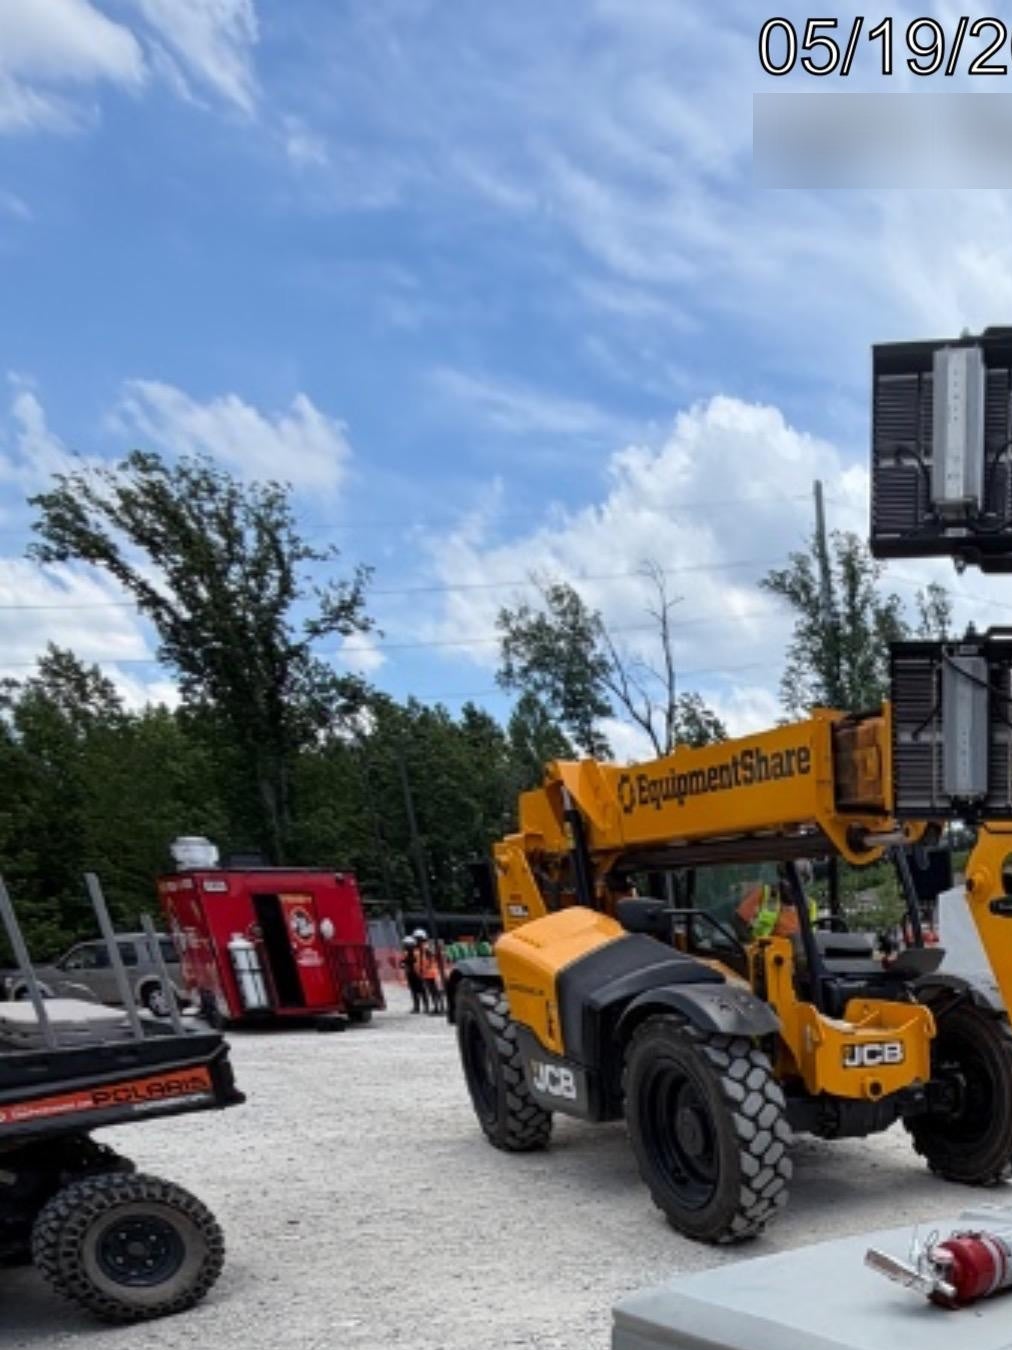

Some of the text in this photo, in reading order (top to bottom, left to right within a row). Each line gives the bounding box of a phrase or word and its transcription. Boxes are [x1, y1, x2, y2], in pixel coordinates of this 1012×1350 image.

[636, 746, 811, 810] EquipmentShare
[842, 1041, 904, 1068] JCB
[92, 1076, 208, 1105] POLARIS
[530, 1060, 577, 1099] JCB
